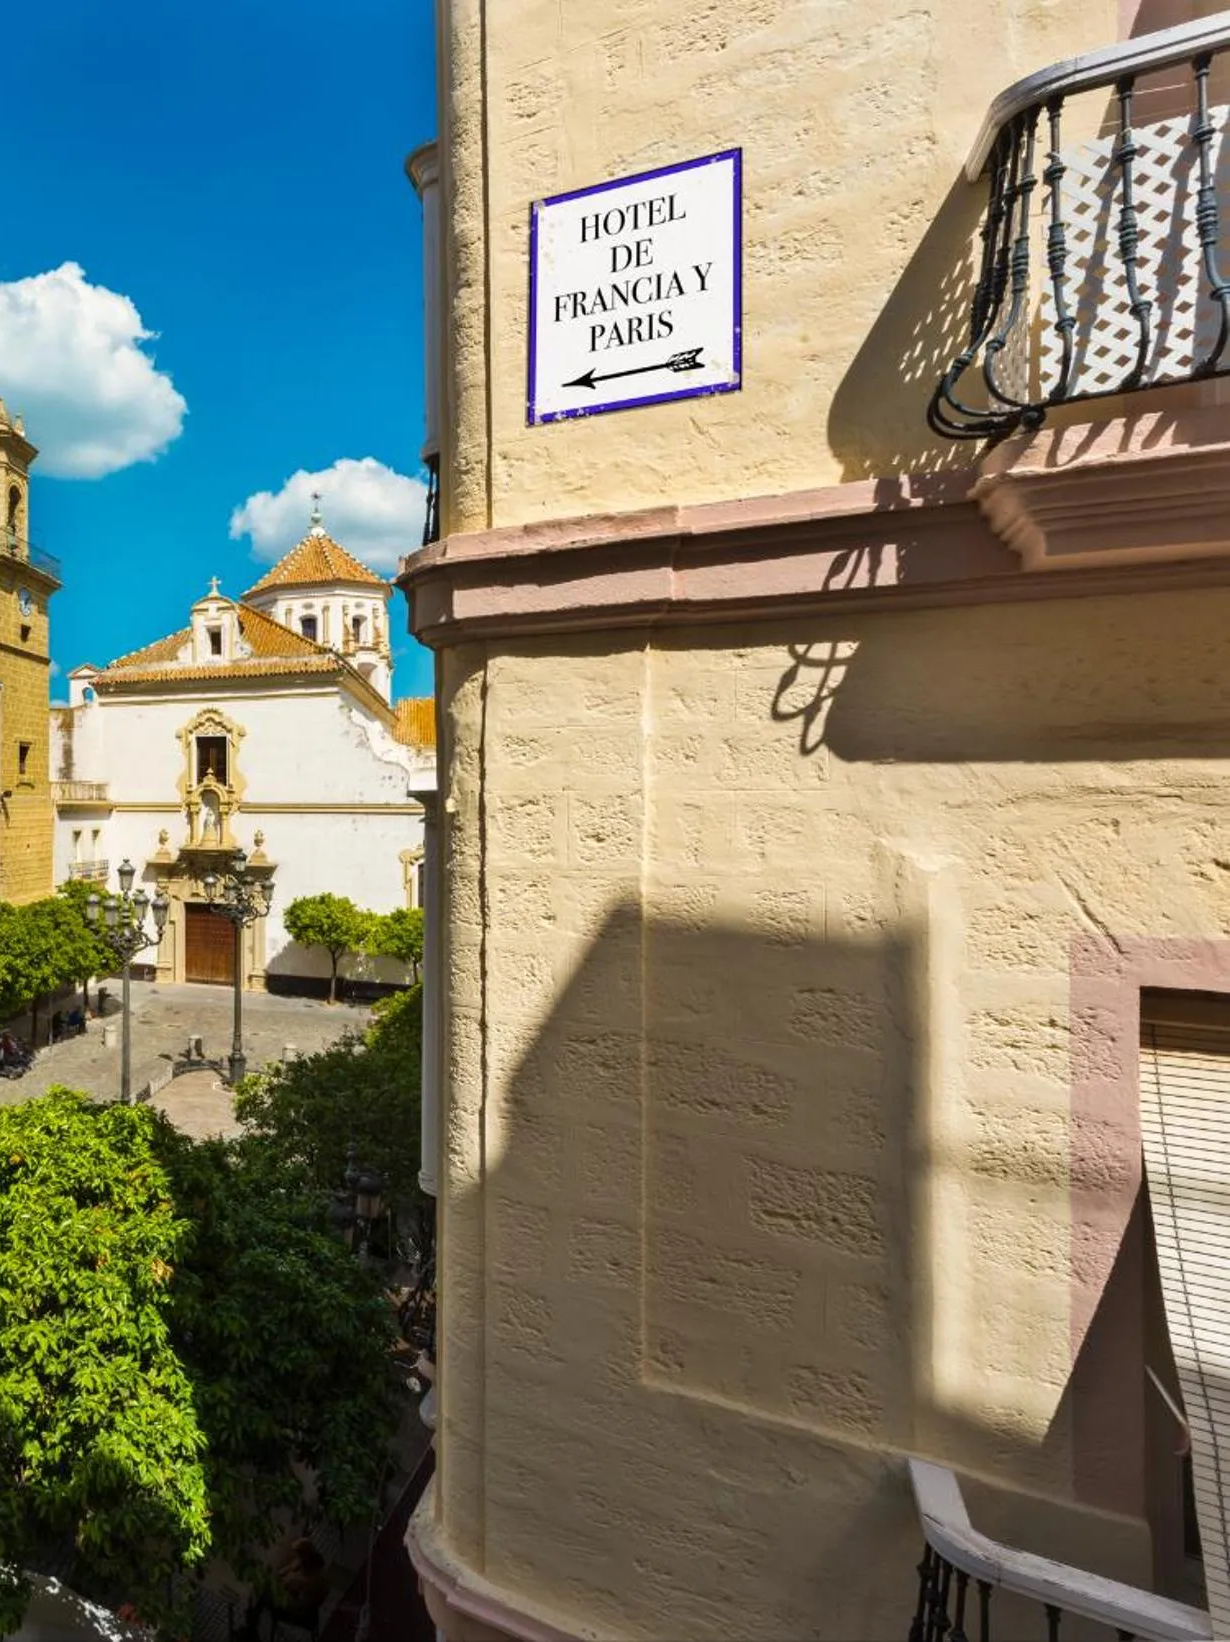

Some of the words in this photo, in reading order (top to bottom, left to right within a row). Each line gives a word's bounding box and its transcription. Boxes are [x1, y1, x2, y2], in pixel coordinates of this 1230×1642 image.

[581, 194, 686, 243] HOTEL
[610, 239, 653, 273] DE
[554, 271, 686, 322] FRANCIA
[692, 262, 713, 292] Y
[589, 310, 674, 352] PARIS
